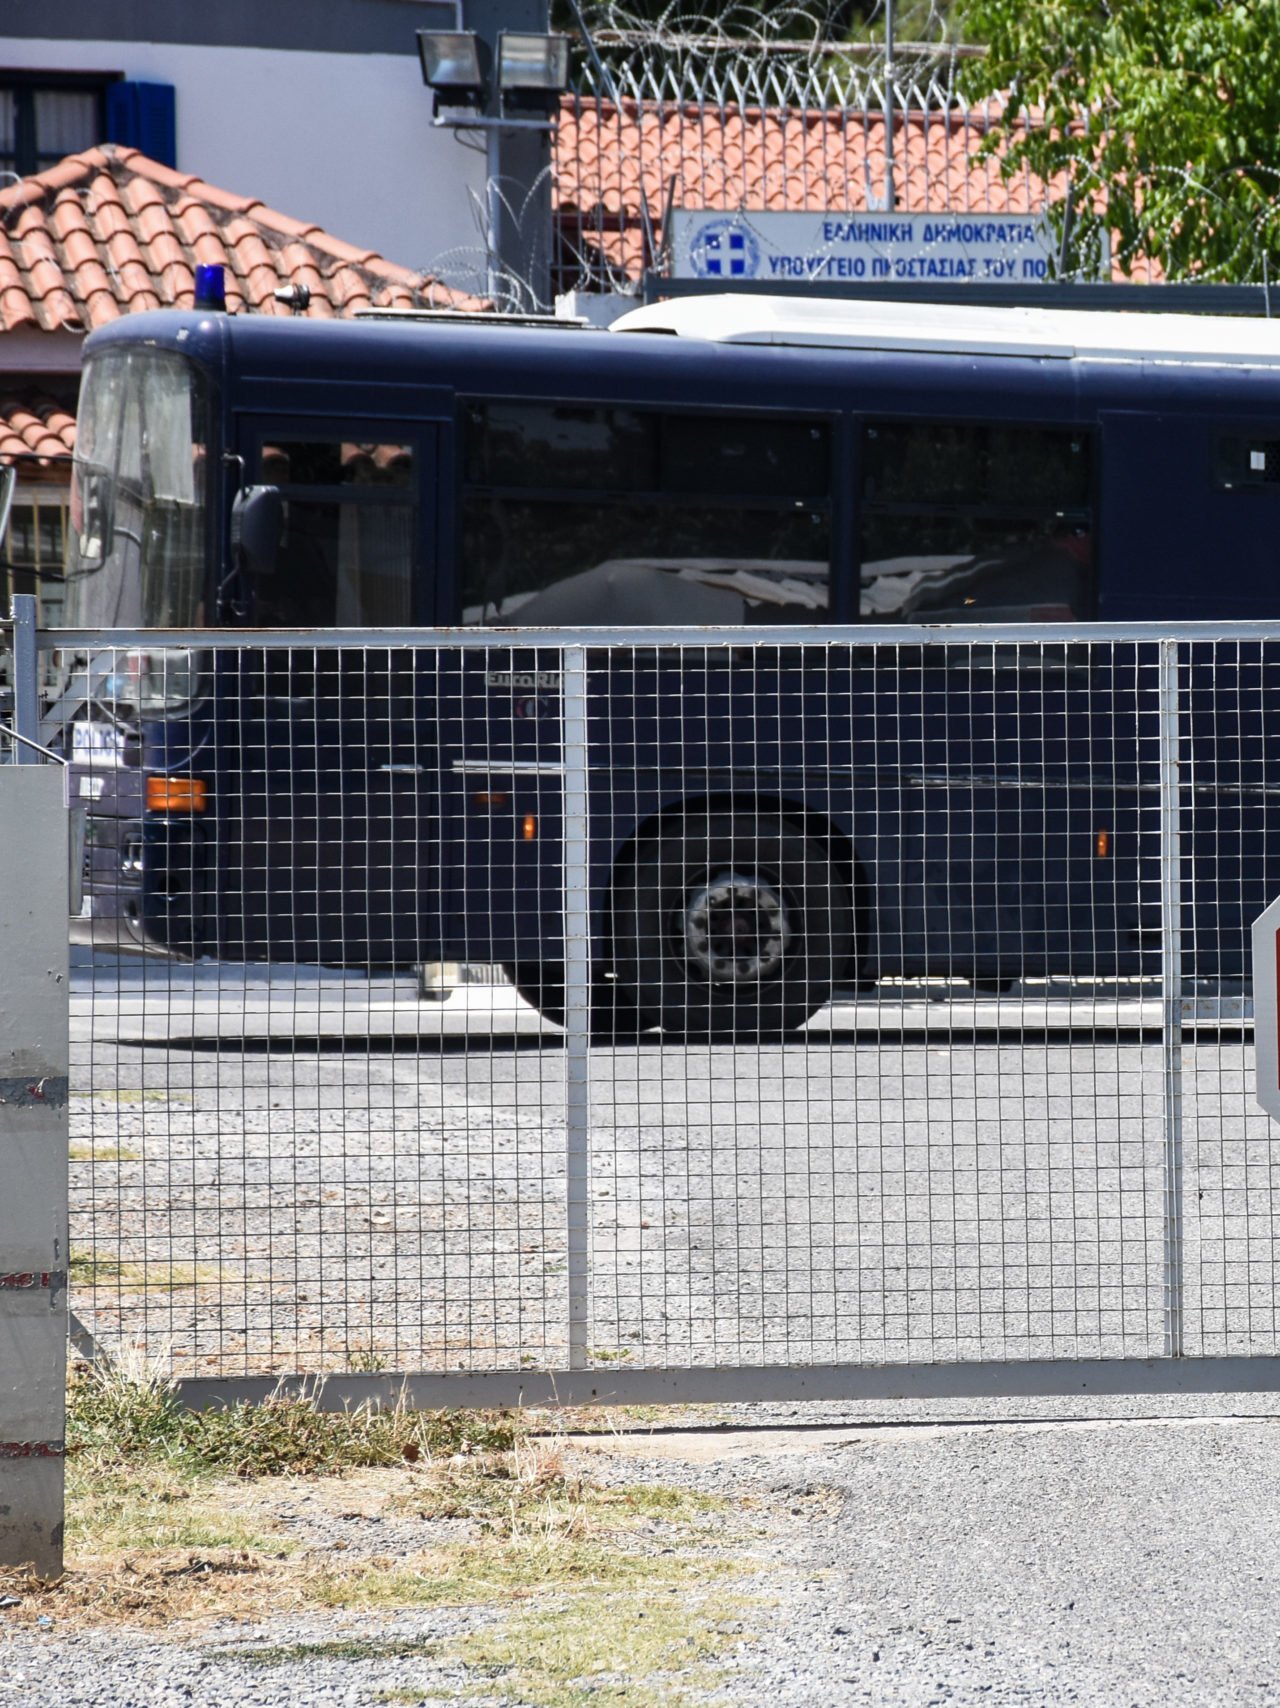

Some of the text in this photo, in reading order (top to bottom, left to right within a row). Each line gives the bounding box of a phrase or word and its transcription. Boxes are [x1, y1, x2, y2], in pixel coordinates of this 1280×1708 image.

[823, 222, 1035, 243] ΕΛΛΗΝΙΚΗ ΔΗΜΟΚΡΑΤΙΑ
[769, 256, 1047, 278] ΥΠΟΥΡΓΕΙΟ ΠΡΟΣΤΑΣΙΑΣ ΤΟΥ ΠΟ
